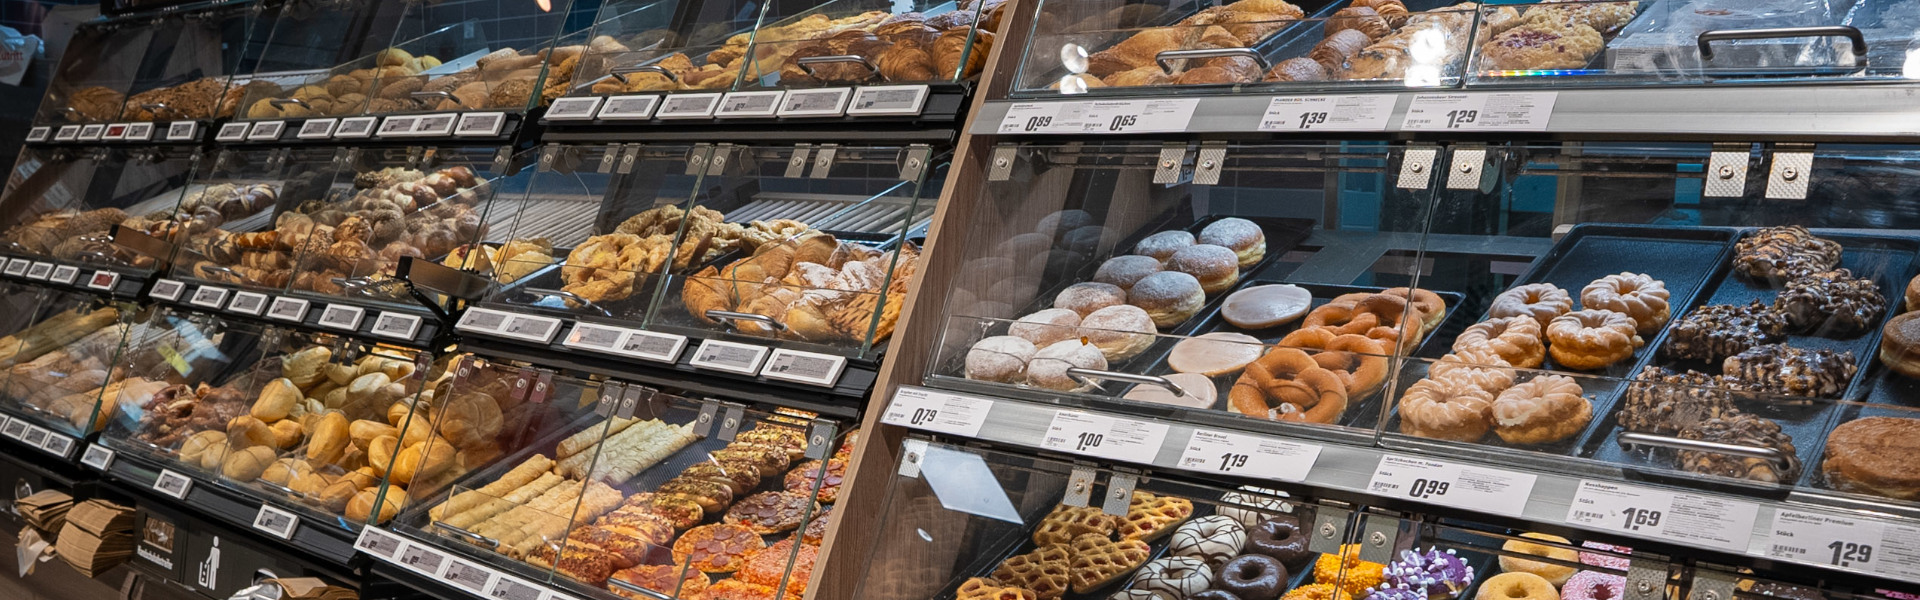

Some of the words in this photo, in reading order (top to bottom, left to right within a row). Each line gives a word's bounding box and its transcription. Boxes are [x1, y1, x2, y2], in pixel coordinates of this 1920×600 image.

[1025, 116, 1052, 132] 0.89
[1109, 114, 1137, 131] 0.65
[1299, 111, 1328, 129] 1.39
[1446, 109, 1477, 128] 1.29
[910, 407, 937, 426] 0.79
[1076, 431, 1103, 451] 1.00
[1219, 452, 1248, 471] 1.19
[1409, 478, 1450, 499] 0.99
[1622, 507, 1662, 531] 1.69
[1828, 540, 1873, 567] 1.29
